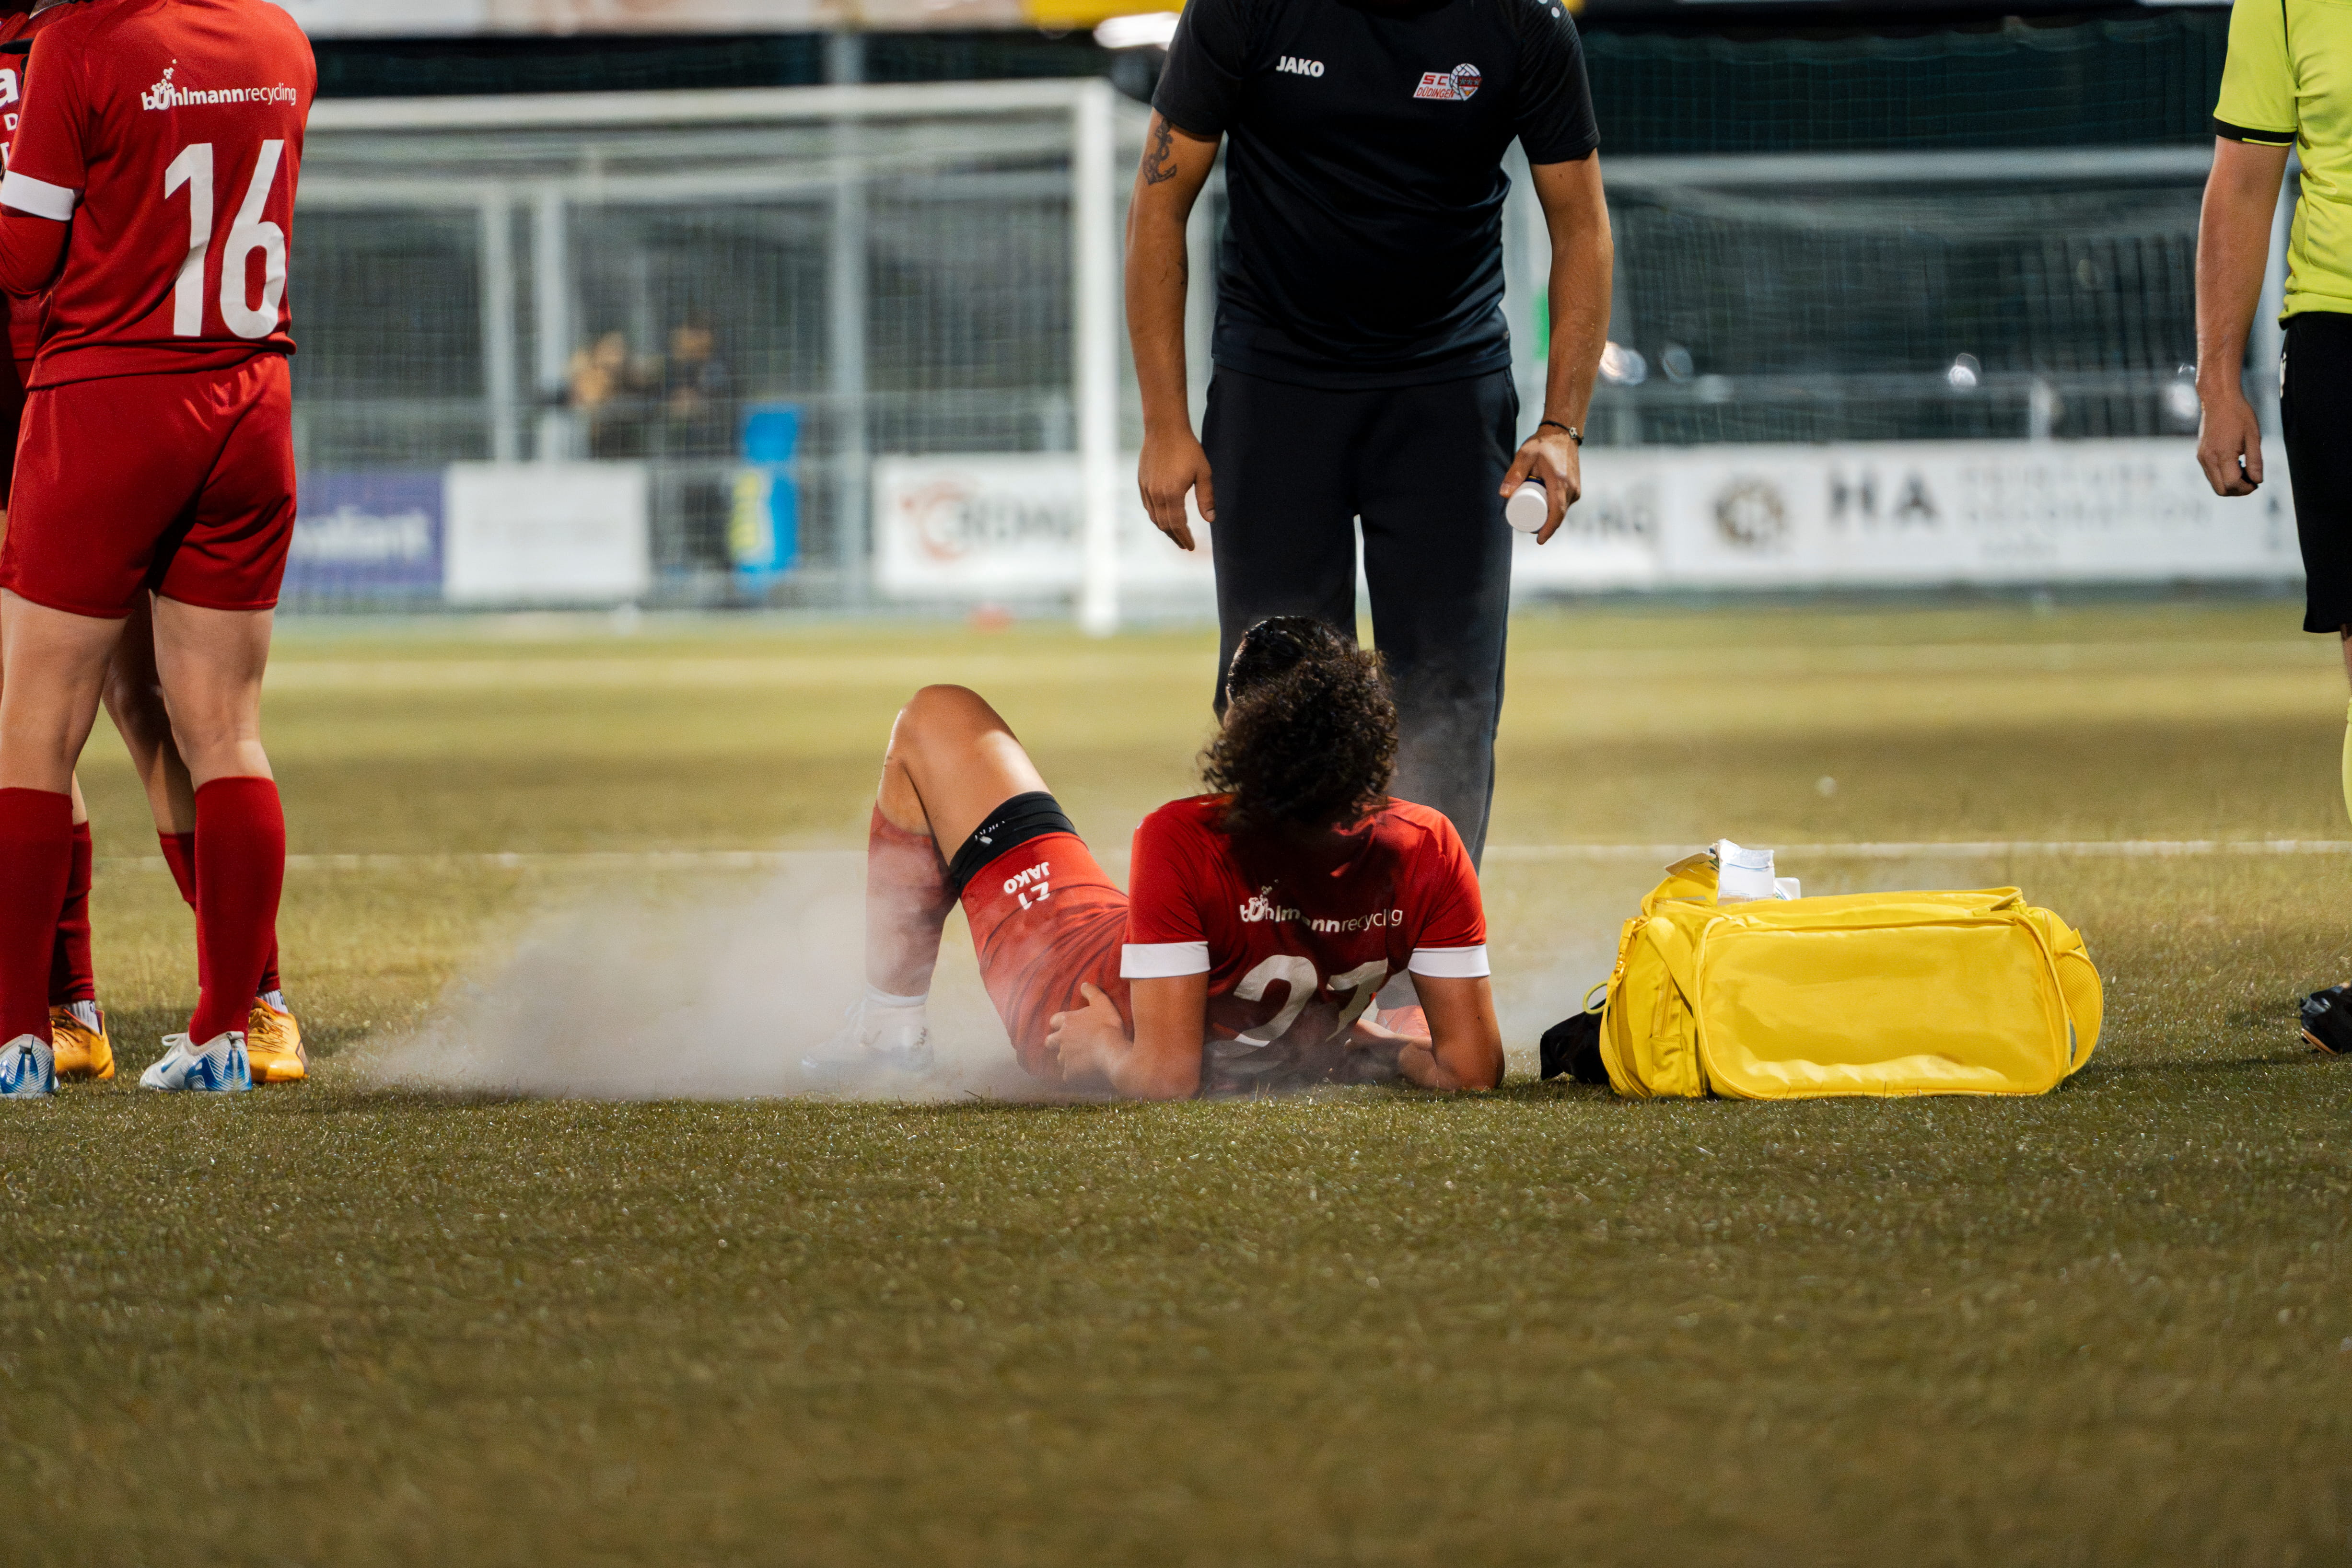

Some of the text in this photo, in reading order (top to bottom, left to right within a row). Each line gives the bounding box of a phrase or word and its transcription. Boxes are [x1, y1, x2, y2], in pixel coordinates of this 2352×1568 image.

[1276, 56, 1324, 77] JAKO
[165, 139, 286, 338] 16
[1003, 862, 1050, 894] JAKO
[1220, 954, 1389, 1053] 27
